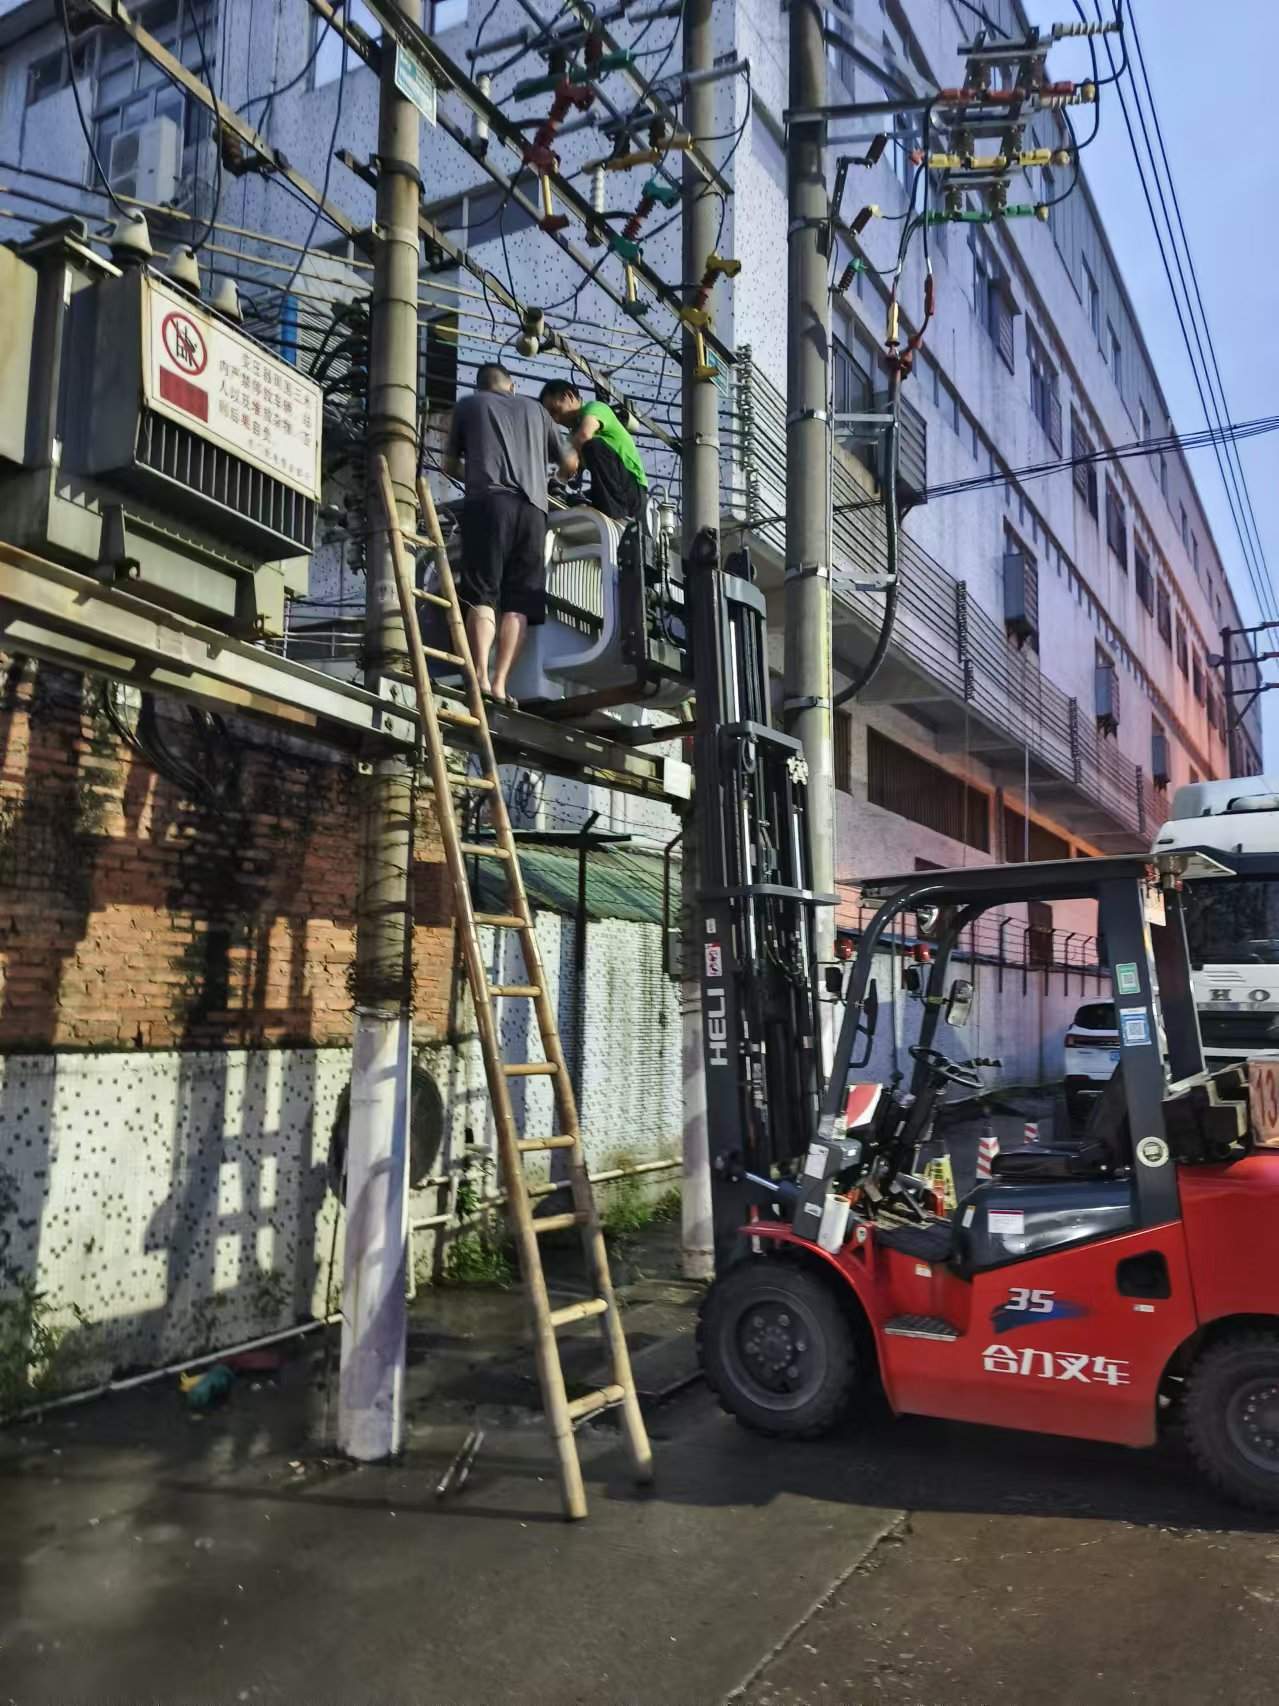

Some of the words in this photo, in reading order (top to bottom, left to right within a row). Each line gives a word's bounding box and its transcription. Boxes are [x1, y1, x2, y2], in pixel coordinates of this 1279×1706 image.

[706, 988, 728, 1066] HELI
[1005, 1287, 1056, 1313] 35
[981, 1344, 1131, 1386] 合力叉车
